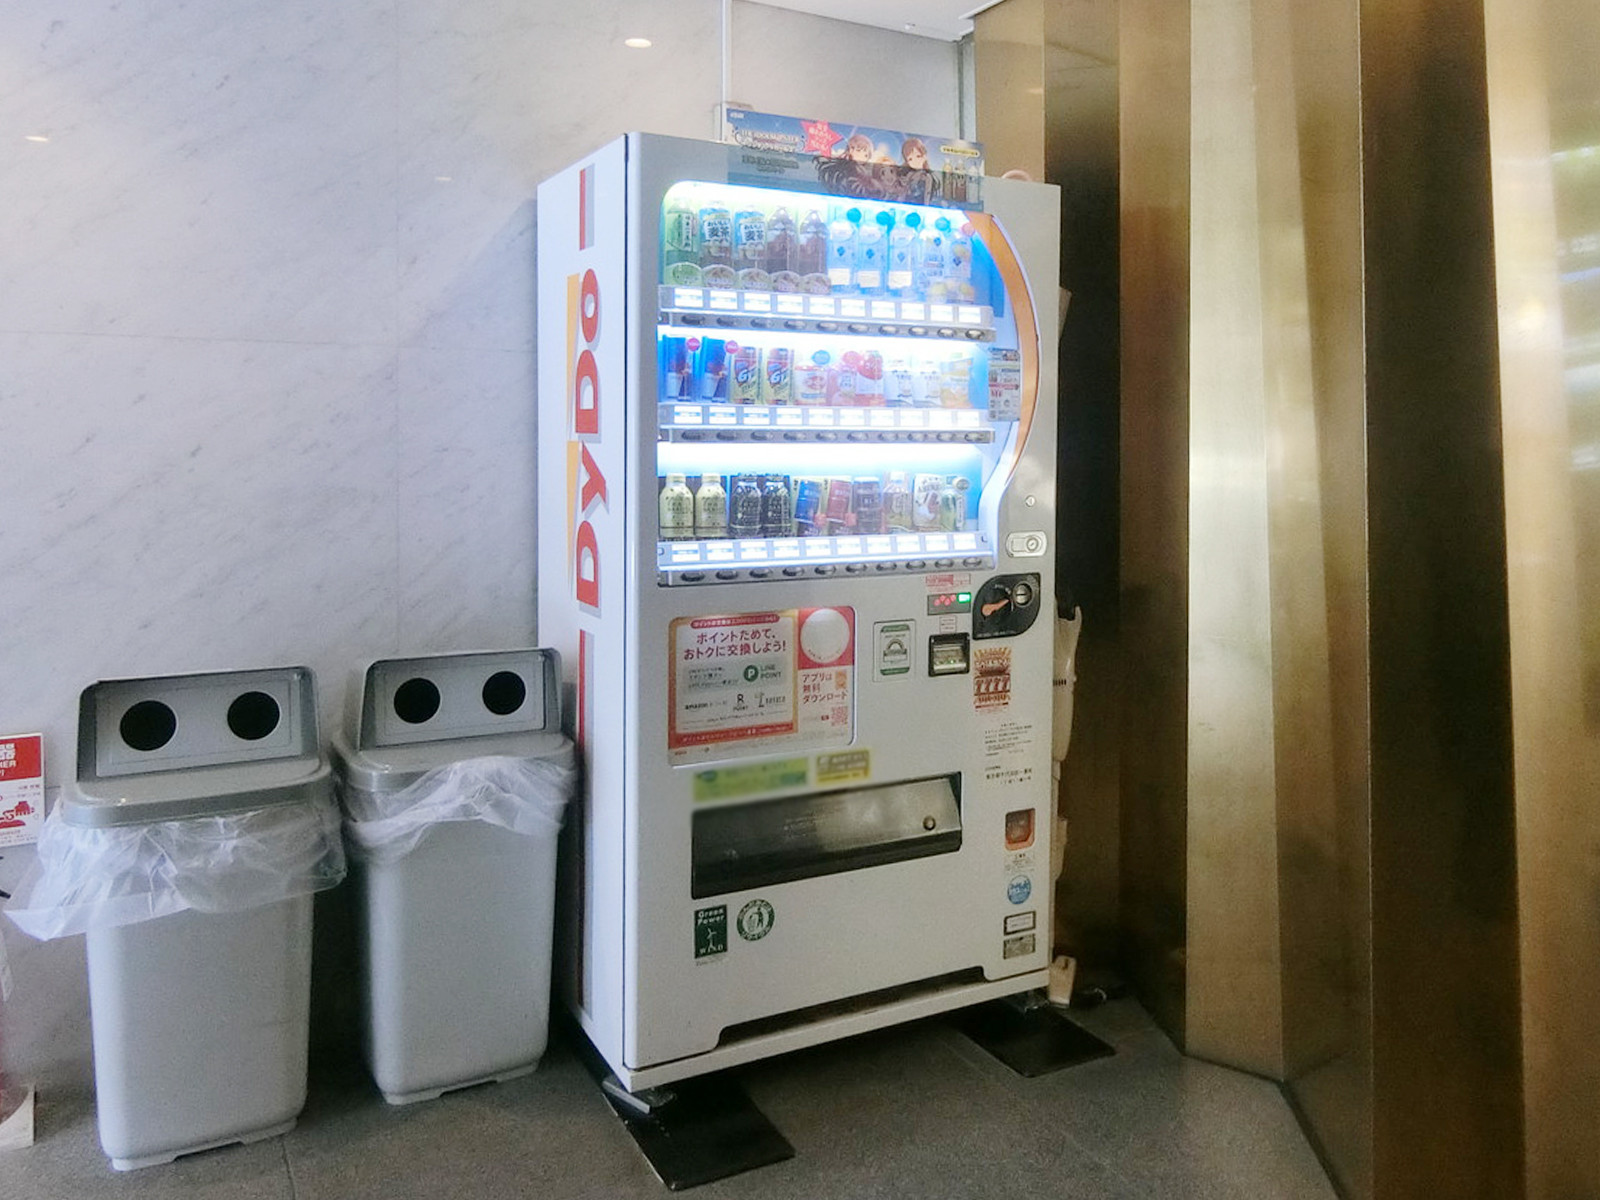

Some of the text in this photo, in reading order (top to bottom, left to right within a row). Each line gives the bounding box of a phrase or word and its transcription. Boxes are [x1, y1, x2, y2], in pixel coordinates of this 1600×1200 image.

[708, 226, 730, 239] 麦茶
[684, 640, 786, 660] おトクに交換しよう!
[760, 671, 782, 679] POINT
[802, 673, 832, 683] アプリは
[803, 683, 821, 693] 無料
[803, 690, 848, 704] ダウンロード
[698, 909, 724, 918] Green
[697, 915, 725, 926] Power
